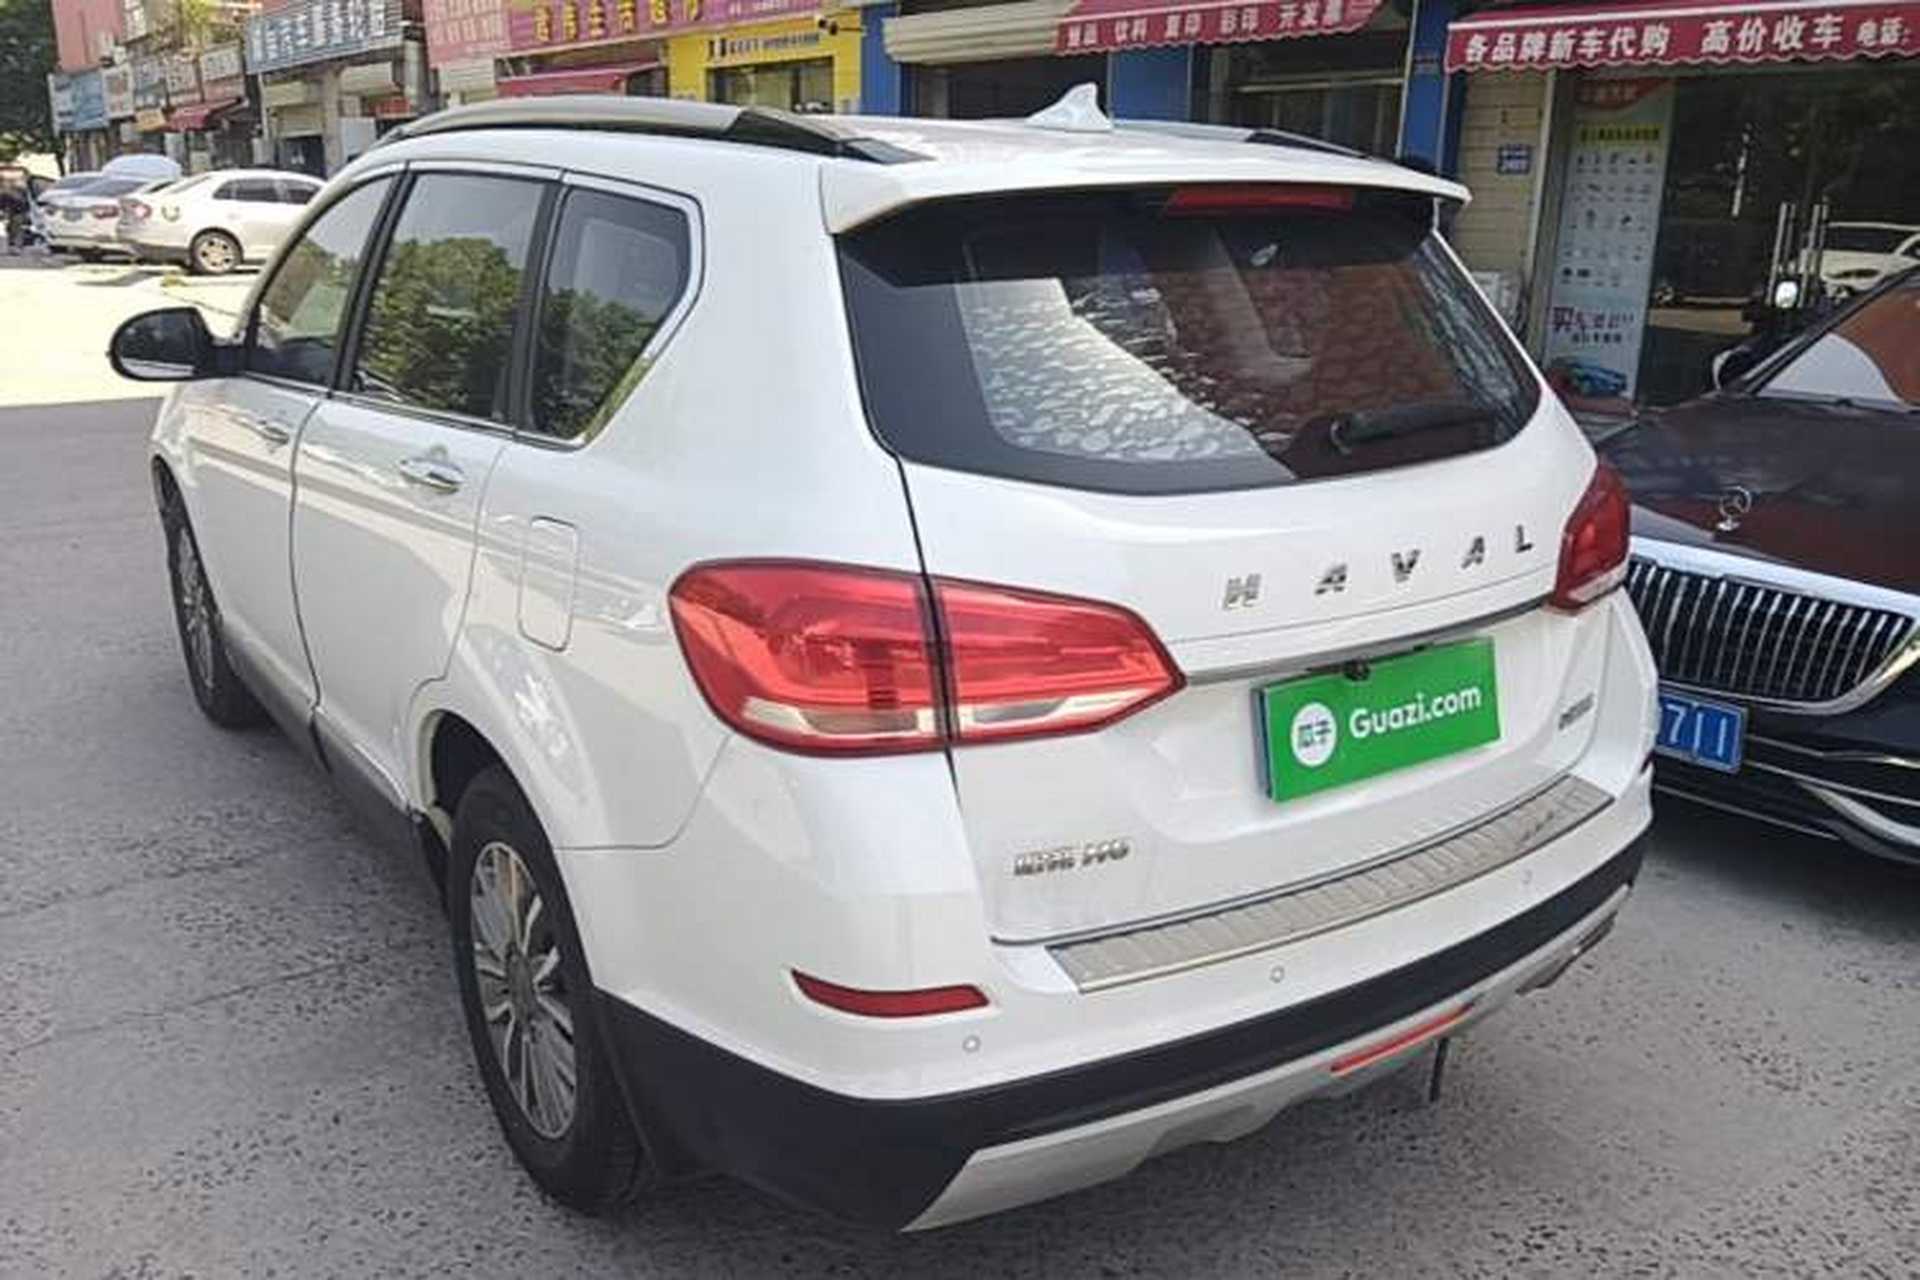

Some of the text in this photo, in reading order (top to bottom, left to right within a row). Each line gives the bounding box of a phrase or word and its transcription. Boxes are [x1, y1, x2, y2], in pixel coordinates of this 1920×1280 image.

[1465, 23, 1671, 63] 各品牌新车代购
[1700, 14, 1844, 54] 高价收车
[1223, 525, 1533, 609] HAVAL
[1349, 686, 1483, 739] Guazi.com
[1665, 703, 1728, 757] 711
